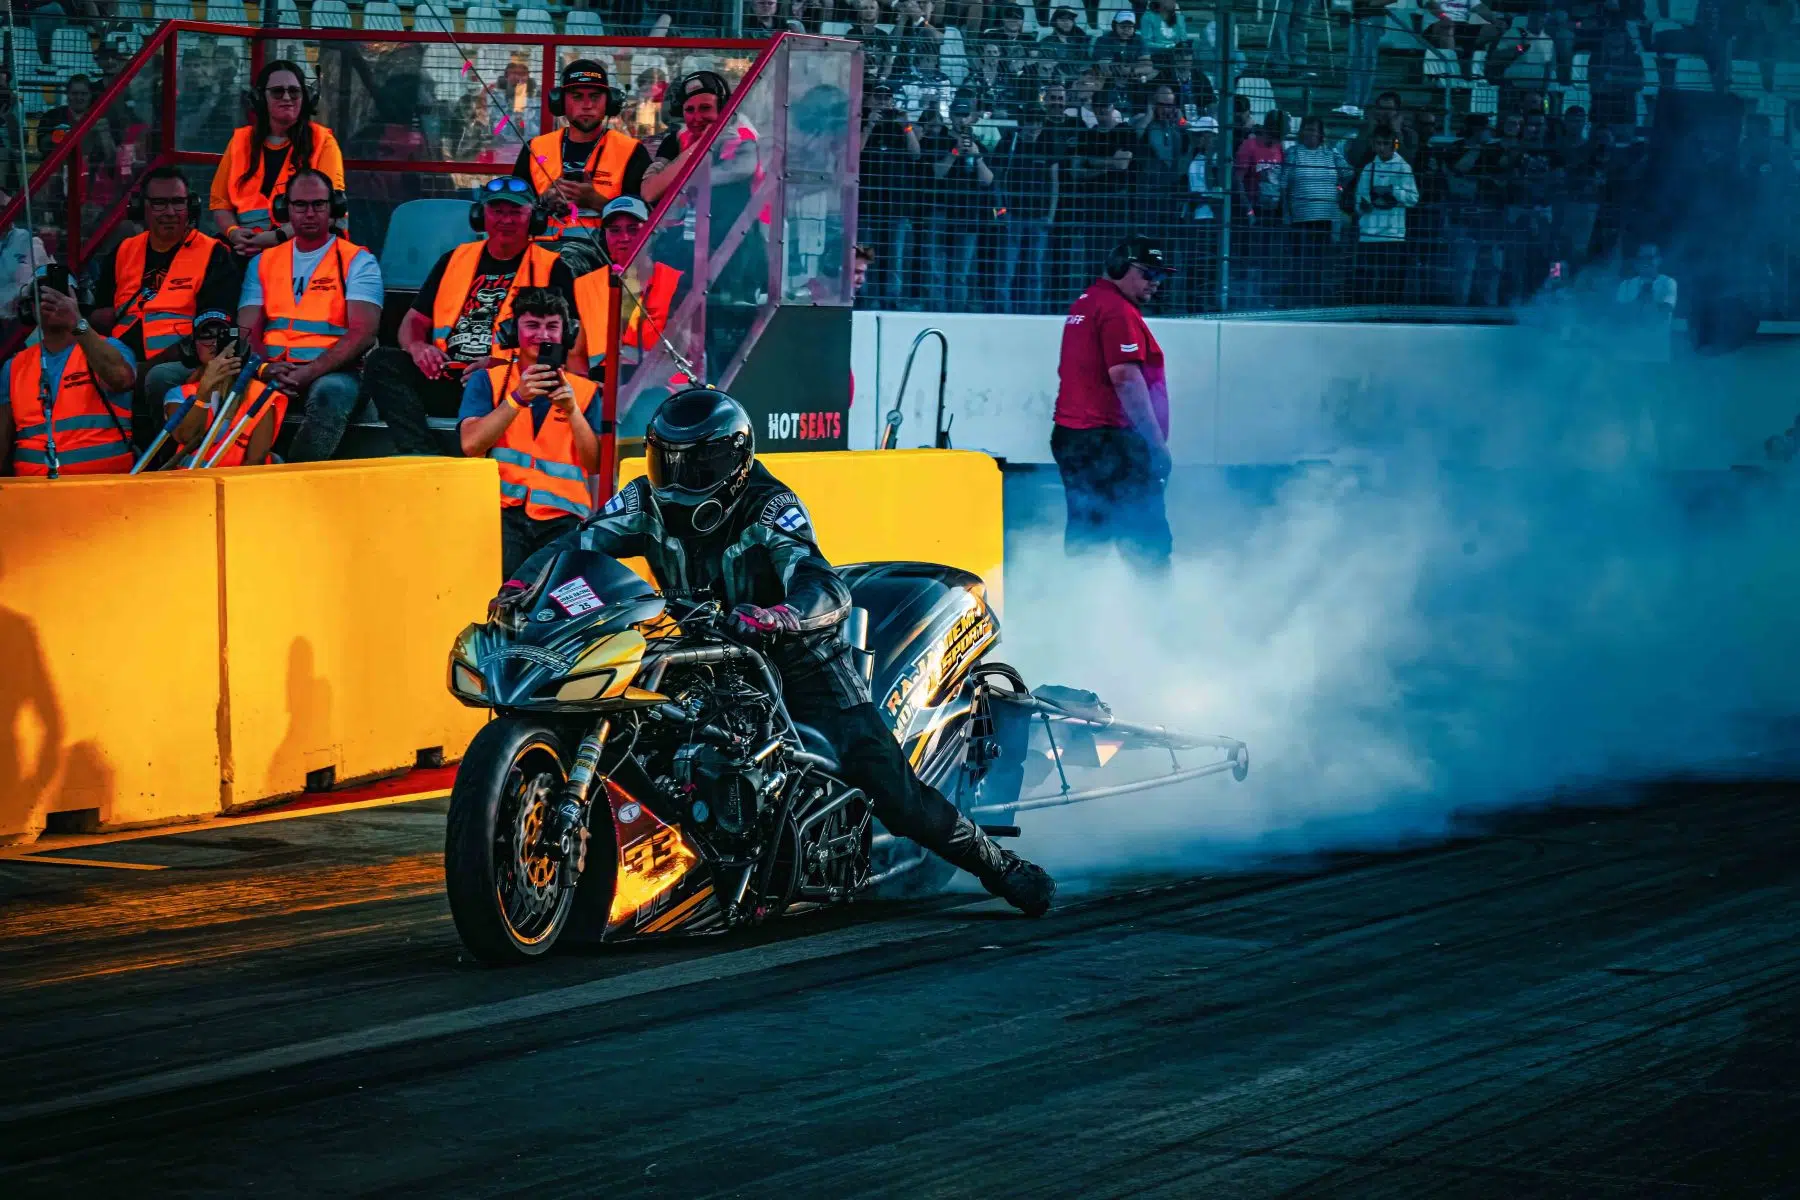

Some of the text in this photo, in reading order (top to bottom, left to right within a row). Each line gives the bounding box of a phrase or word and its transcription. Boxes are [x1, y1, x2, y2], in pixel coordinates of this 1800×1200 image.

[768, 412, 841, 440] HOTSEATS
[761, 493, 797, 527] KALAFORNIA
[579, 602, 591, 611] 25
